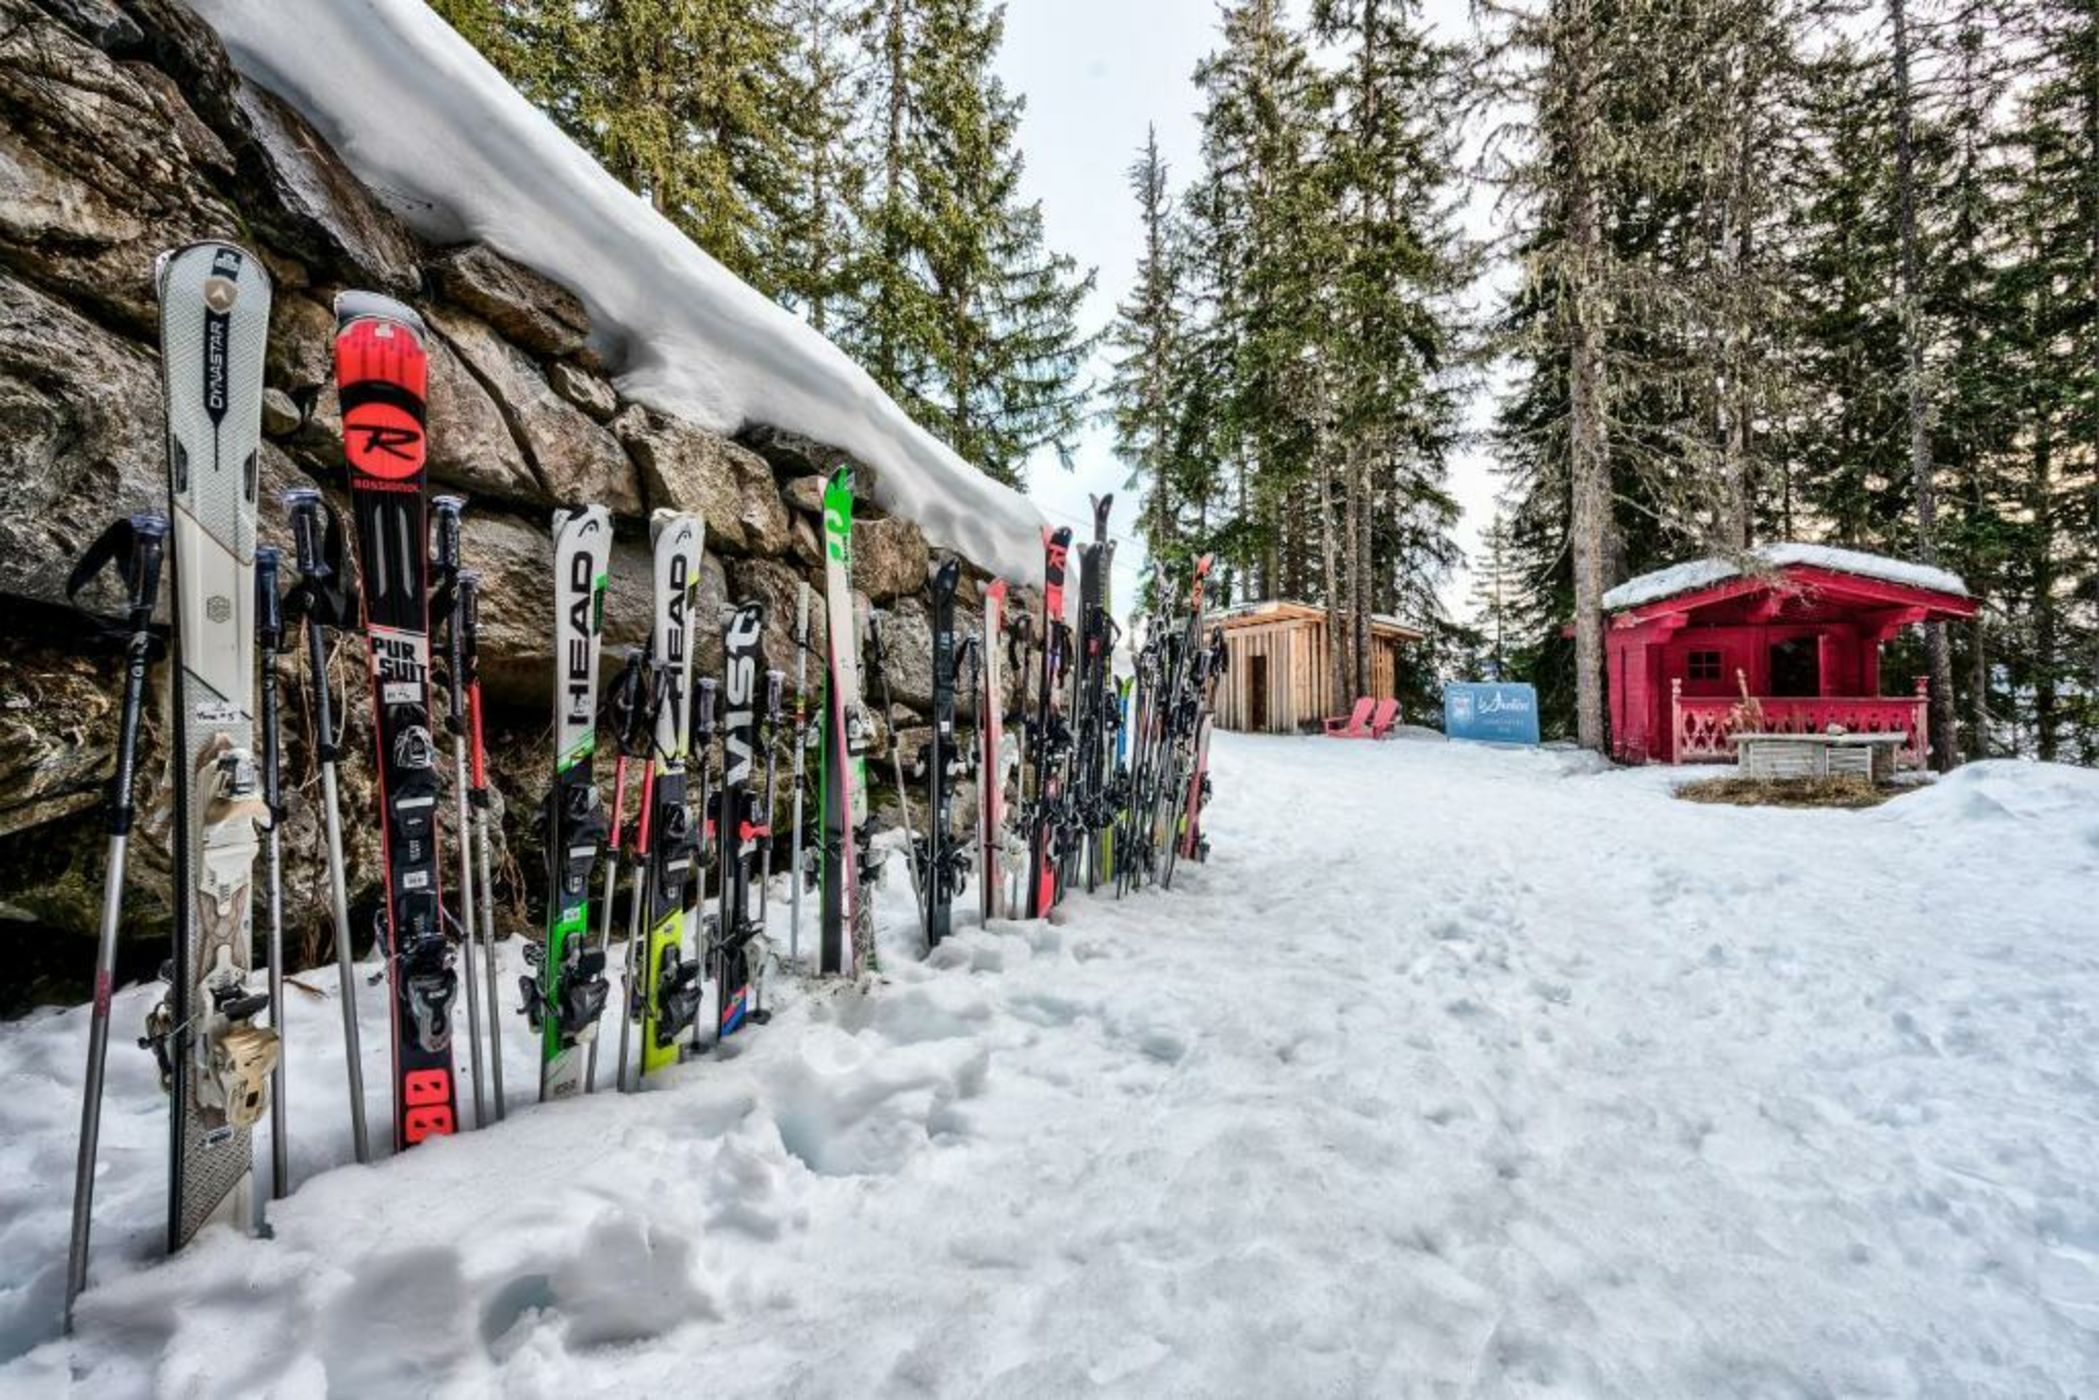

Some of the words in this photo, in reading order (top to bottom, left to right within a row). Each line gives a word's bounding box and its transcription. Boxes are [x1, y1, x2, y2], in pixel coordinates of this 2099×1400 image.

[209, 320, 223, 409] DYNASTAR
[346, 424, 421, 461] R
[370, 636, 416, 662] PUR
[567, 551, 594, 725] HEAD
[667, 553, 688, 700] HEAD
[379, 657, 428, 683] SUIT
